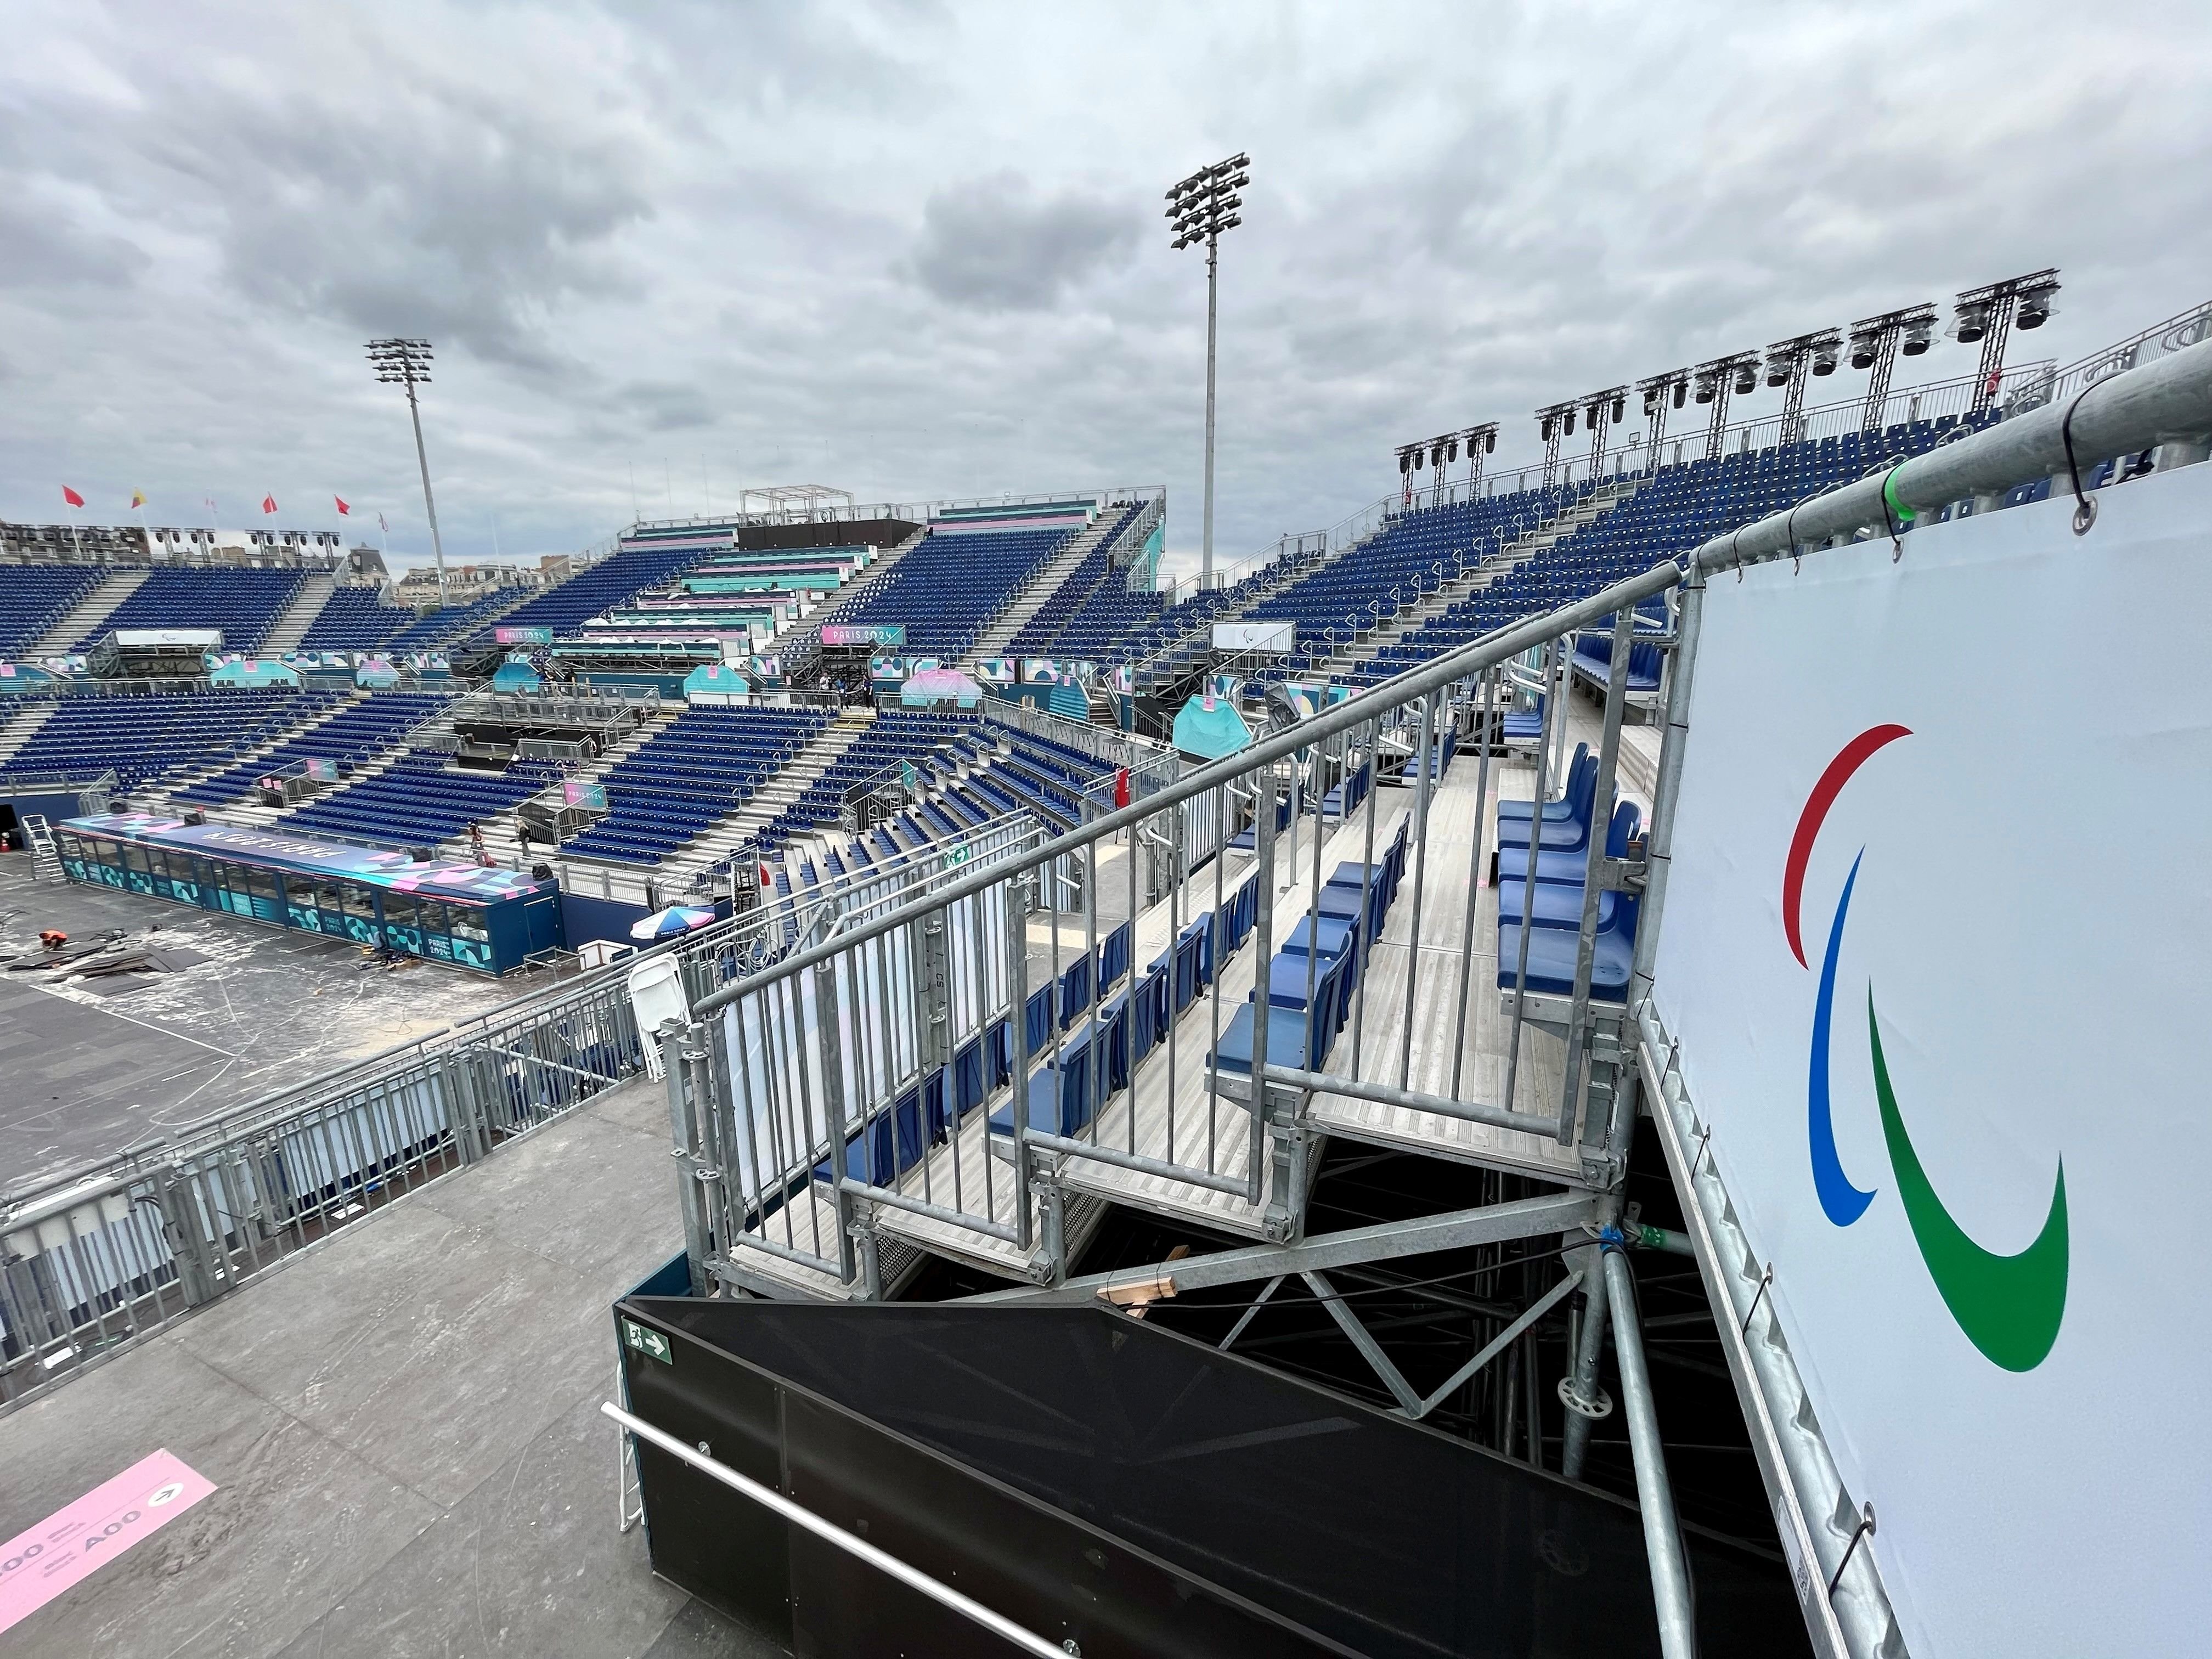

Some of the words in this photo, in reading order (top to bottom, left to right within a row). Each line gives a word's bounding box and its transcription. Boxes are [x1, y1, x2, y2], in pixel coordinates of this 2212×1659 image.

[833, 631, 861, 640] PARIS
[864, 631, 892, 640] 2024
[258, 842, 347, 858] PARIS
[428, 938, 447, 949] PARIS
[430, 946, 448, 956] 2024
[0, 1544, 44, 1577] 00
